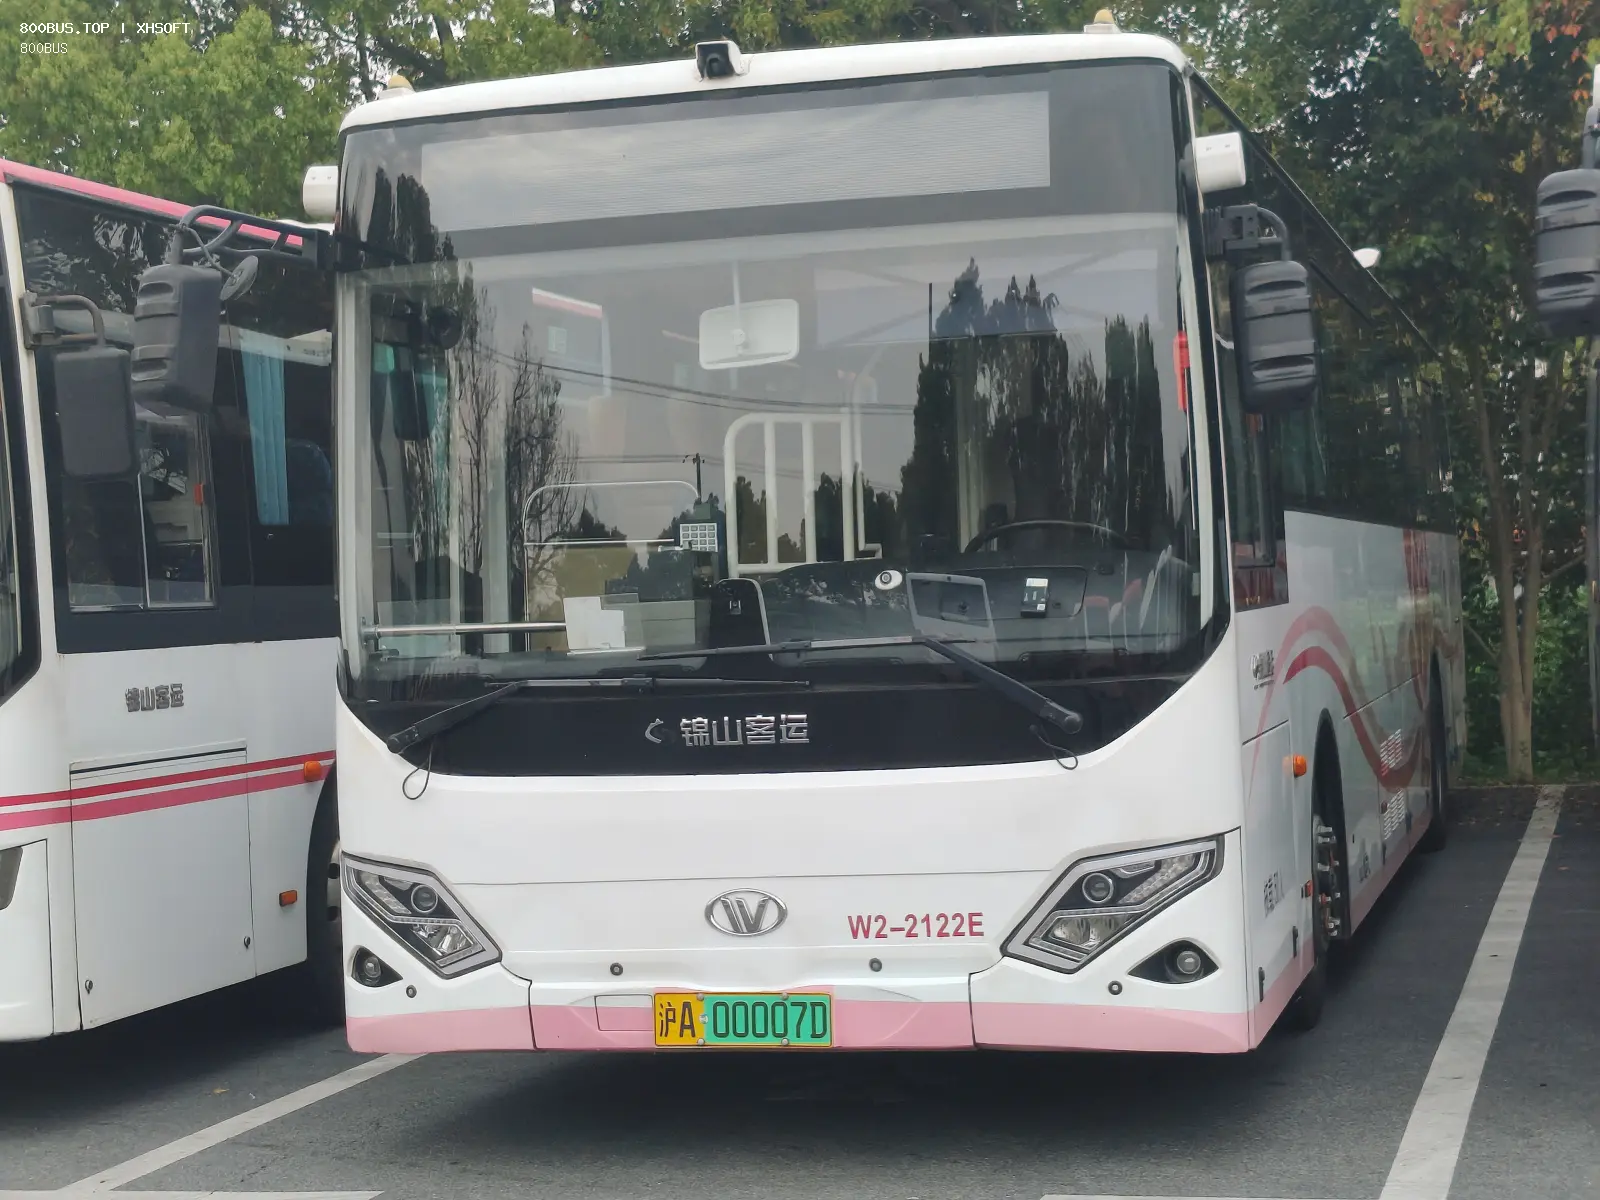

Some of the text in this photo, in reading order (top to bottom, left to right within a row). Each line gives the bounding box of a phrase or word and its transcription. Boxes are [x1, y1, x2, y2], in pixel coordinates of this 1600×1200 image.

[680, 713, 810, 747] 锦山客运
[847, 911, 985, 940] W2-2122E
